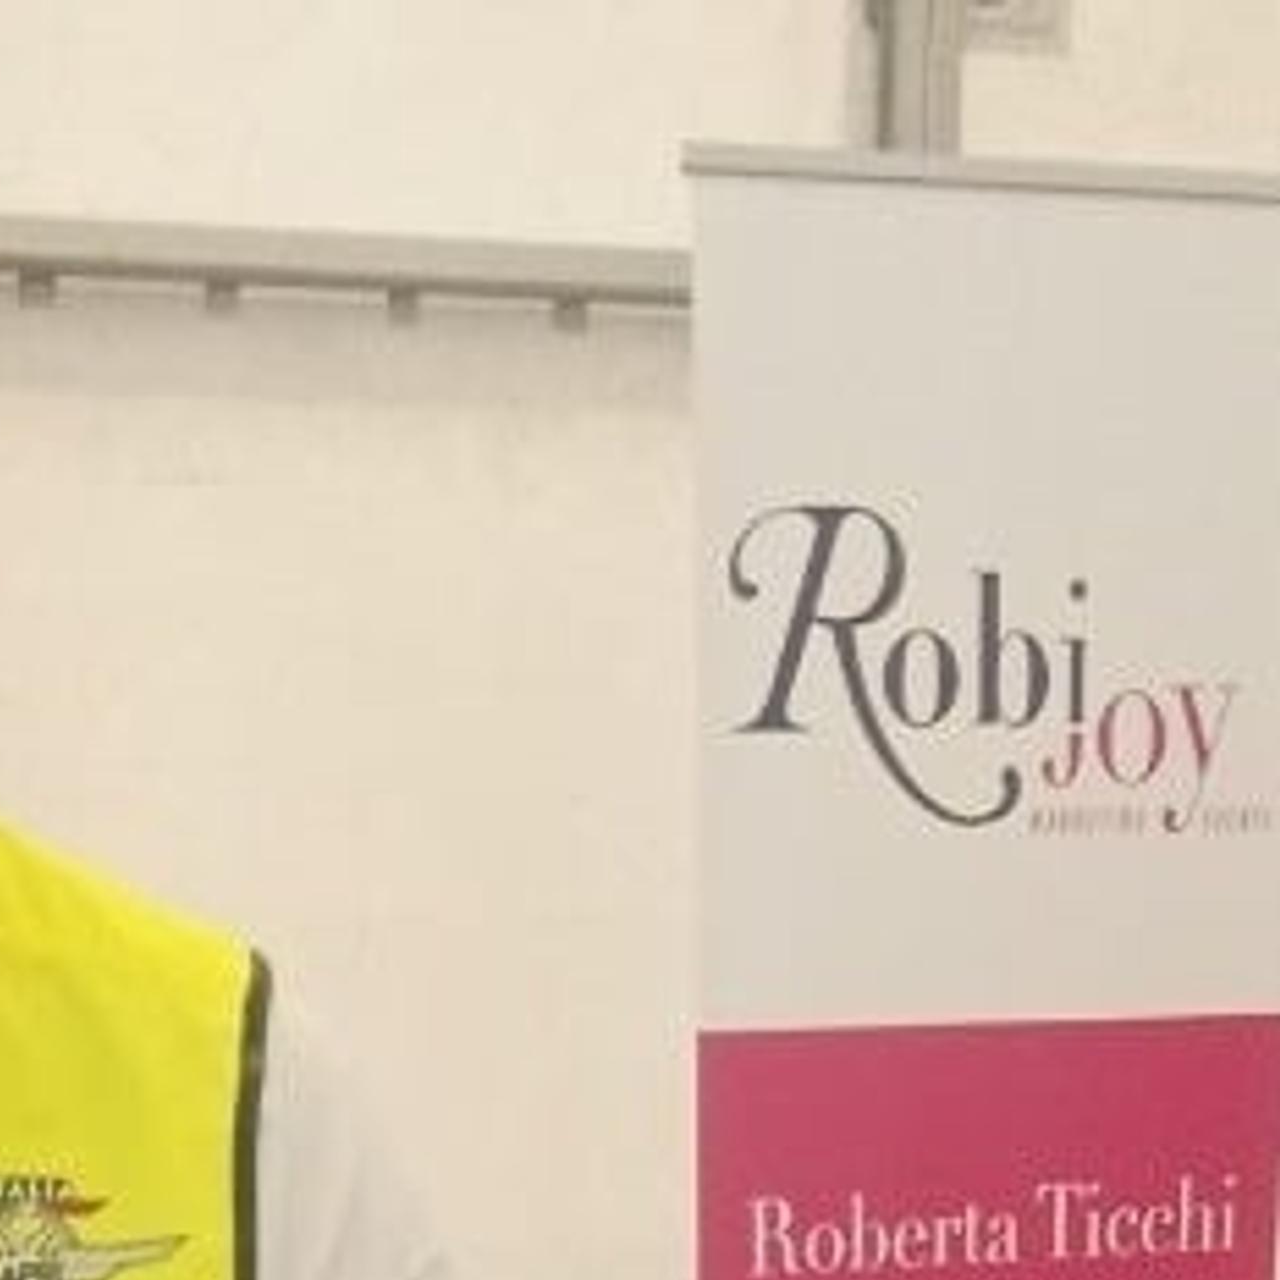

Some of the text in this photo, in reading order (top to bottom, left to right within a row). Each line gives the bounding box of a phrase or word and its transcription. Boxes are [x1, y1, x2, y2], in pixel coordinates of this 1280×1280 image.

[728, 504, 1090, 828] Robi
[746, 1173, 1239, 1280] Roberta Ticchi
